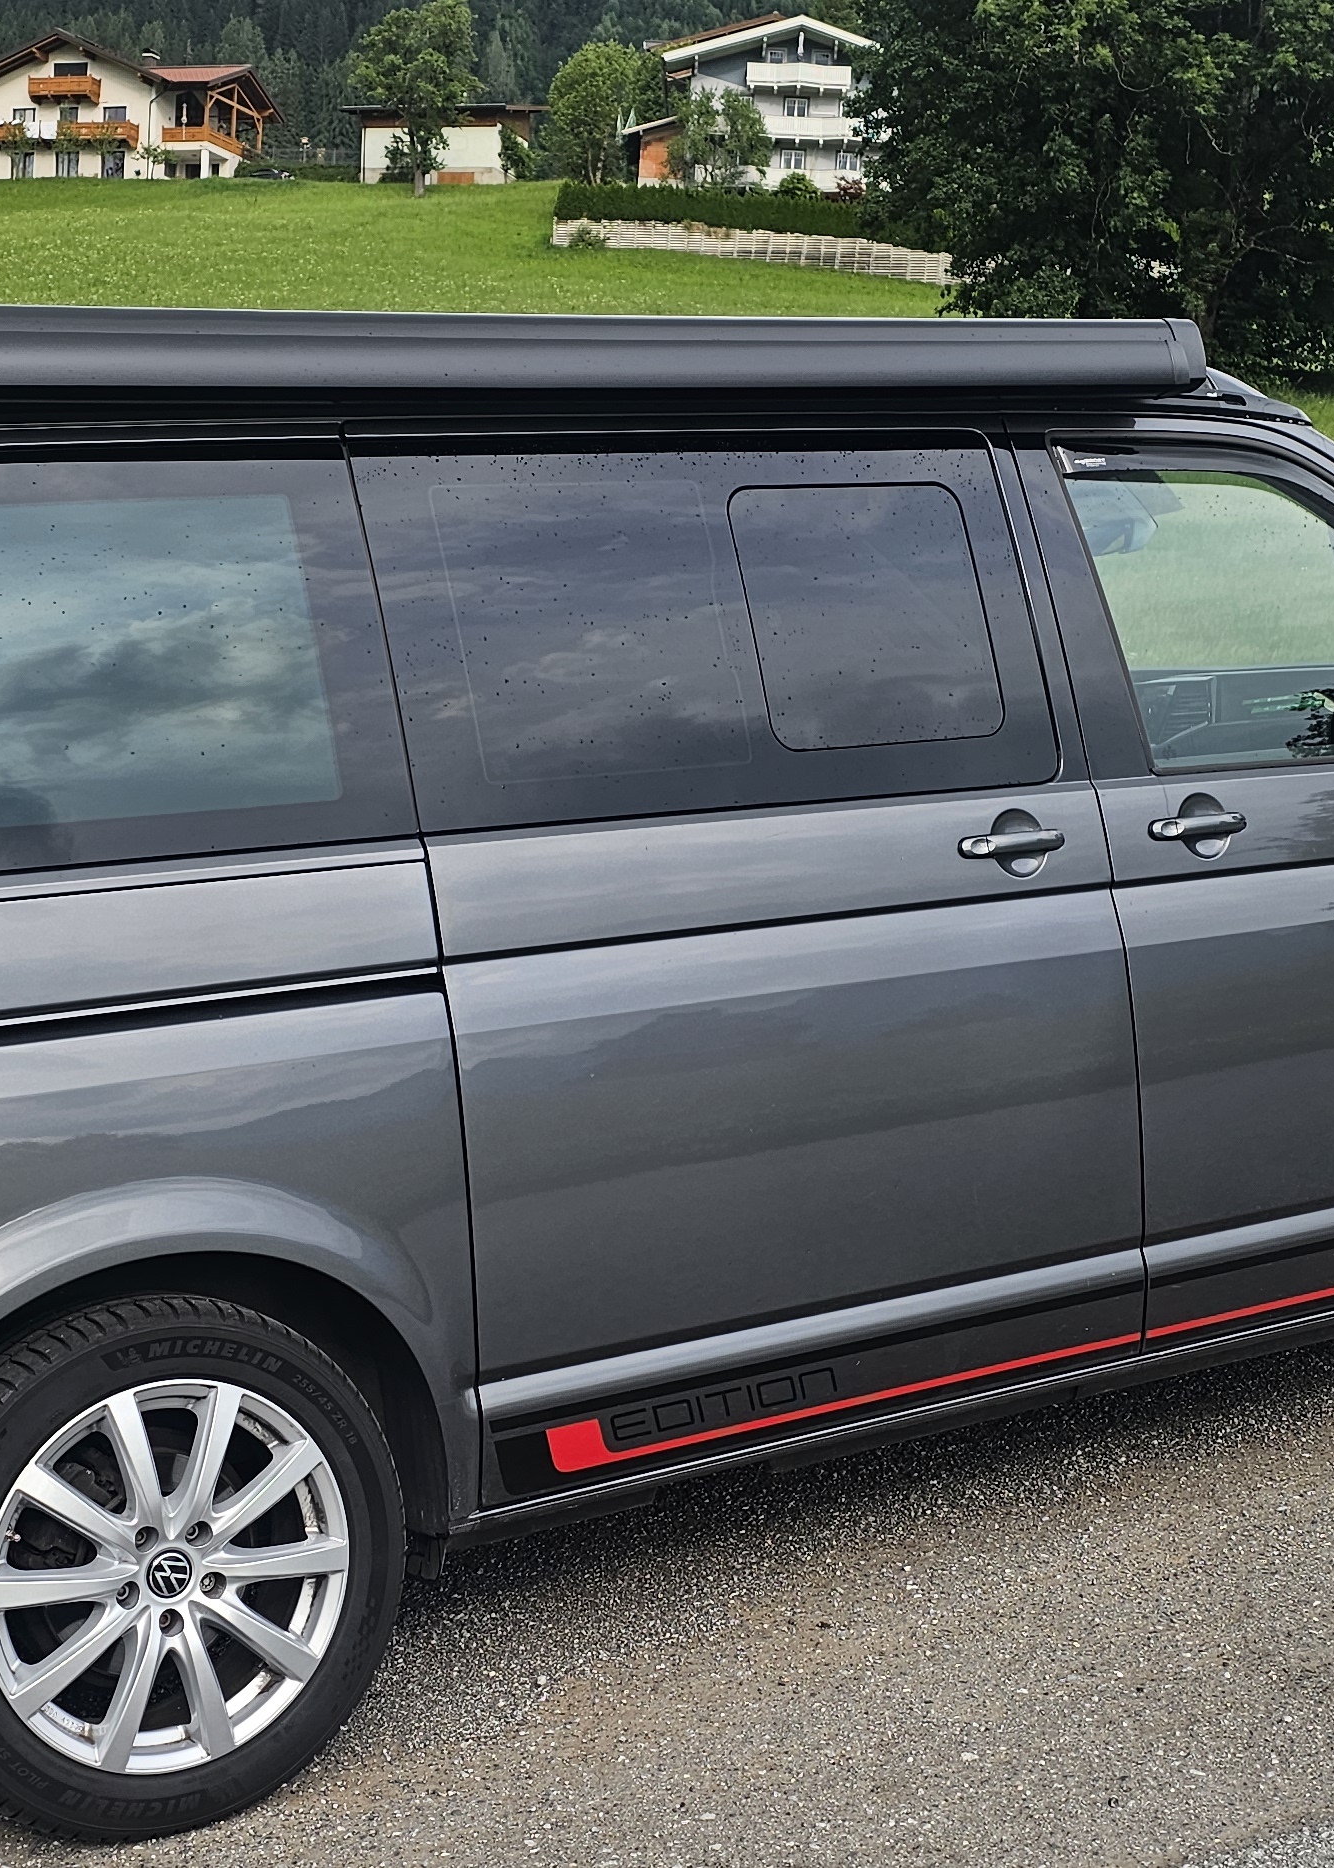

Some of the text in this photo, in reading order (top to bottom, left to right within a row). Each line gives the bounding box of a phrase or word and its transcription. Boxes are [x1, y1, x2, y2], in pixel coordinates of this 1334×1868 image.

[148, 1340, 282, 1373] MICHELIN
[292, 1374, 333, 1410] 255/45
[331, 1408, 348, 1429] ZR
[610, 1367, 838, 1441] EDITION
[61, 1790, 201, 1818] MICHELIN
